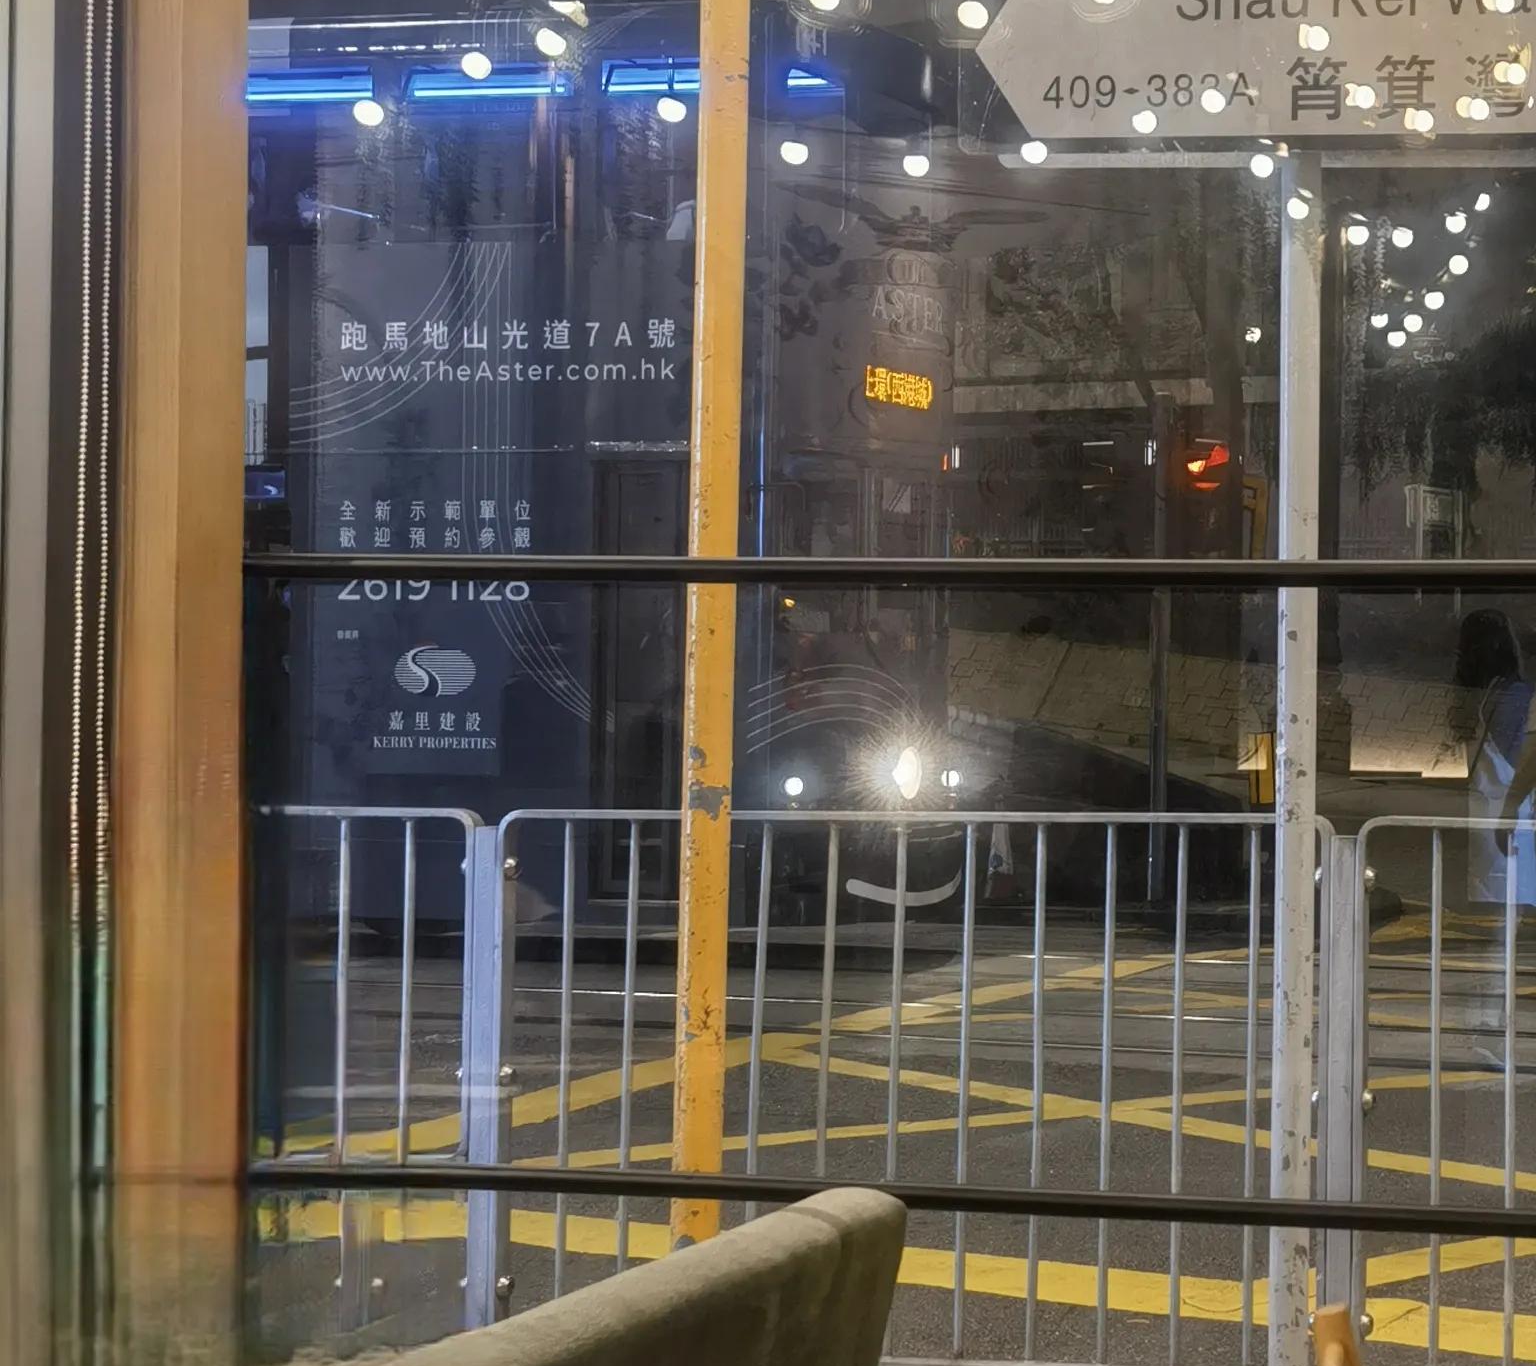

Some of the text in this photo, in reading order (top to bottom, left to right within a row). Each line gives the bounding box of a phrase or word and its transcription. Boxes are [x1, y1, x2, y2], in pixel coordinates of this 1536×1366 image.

[340, 319, 677, 350] 跑馬地山光道7A號
[340, 358, 676, 382] www.TheAster.com.hk
[339, 500, 532, 523] 全新示範單位
[339, 526, 532, 549] 歡迎預約參觀
[337, 579, 431, 601] 2619
[388, 710, 481, 731] 嘉里建設
[373, 736, 497, 749] KERRY PROPERTIES
